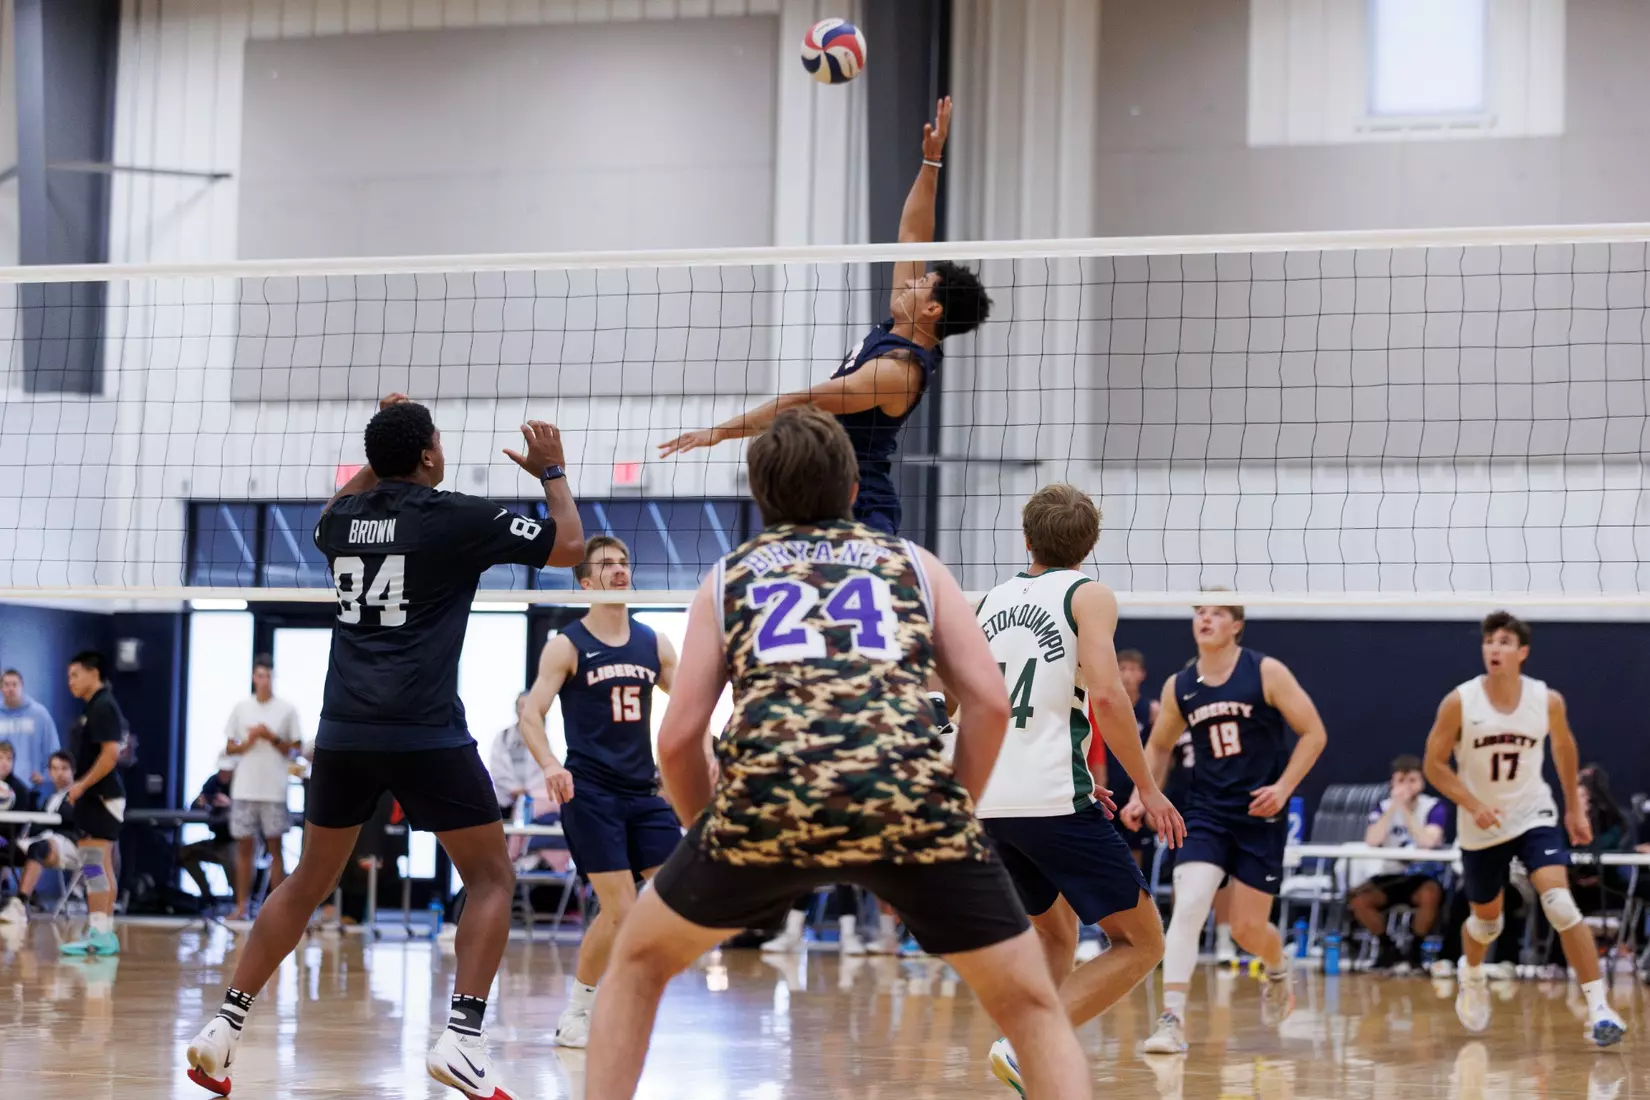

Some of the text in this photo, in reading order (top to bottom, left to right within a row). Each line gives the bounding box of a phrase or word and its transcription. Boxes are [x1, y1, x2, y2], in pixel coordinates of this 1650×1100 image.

[348, 518, 397, 544] BROWN
[509, 514, 542, 541] 8
[741, 540, 893, 577] BRYANT
[333, 554, 410, 627] 84
[746, 573, 903, 664] 24
[586, 663, 657, 687] LIBERTY
[610, 685, 642, 722] 15
[998, 657, 1038, 729] 4
[1187, 700, 1254, 728] LIBERTY
[1208, 720, 1242, 759] 19
[1473, 732, 1538, 750] LIBERTY
[1490, 751, 1520, 782] 17
